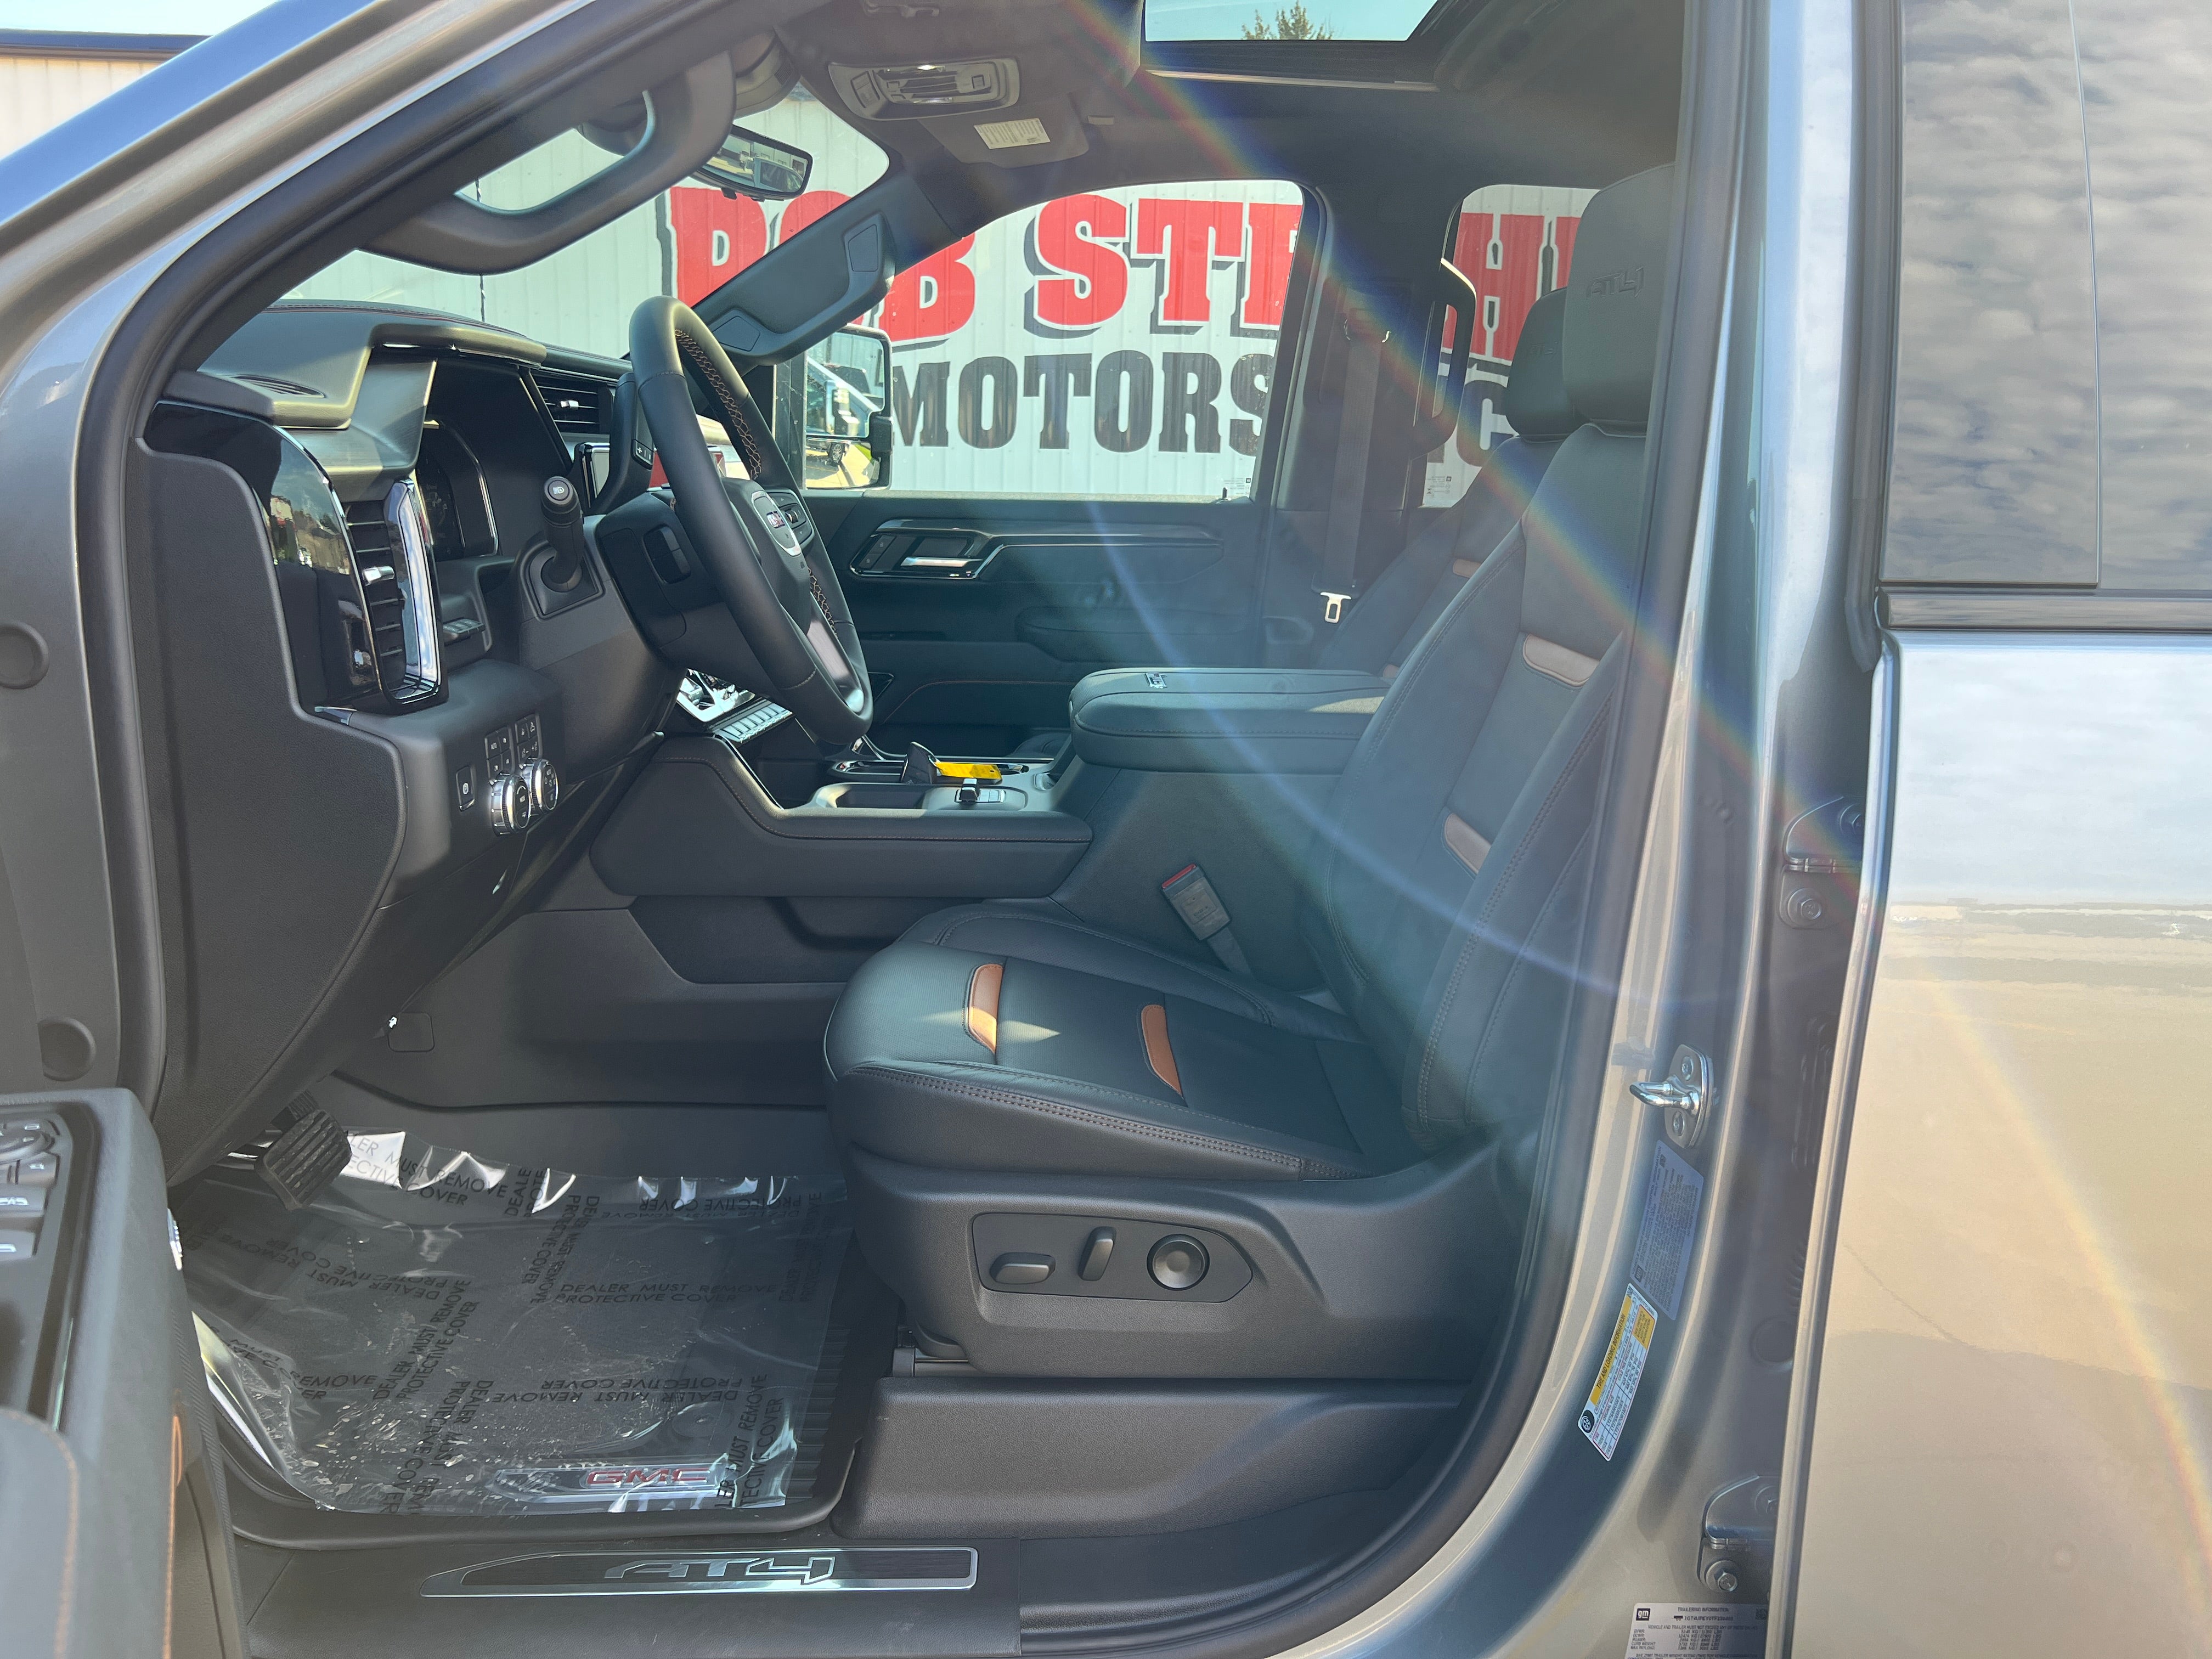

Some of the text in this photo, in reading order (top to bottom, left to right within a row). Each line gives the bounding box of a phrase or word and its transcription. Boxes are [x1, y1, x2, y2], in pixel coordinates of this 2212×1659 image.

[893, 349, 1274, 456] MOTORS
[436, 1169, 509, 1198] REMOVE
[639, 1198, 698, 1212] COVER
[304, 1267, 360, 1288] MUST
[333, 1266, 448, 1289] PROTECTIVE
[521, 1249, 551, 1285] COVER
[368, 1279, 441, 1300] DEALER
[555, 1293, 737, 1305] PROTECTIVE COVER
[560, 1283, 778, 1294] DEALER MUST REMOVE
[373, 1279, 472, 1401] DEALER MUST REMOVE
[395, 1300, 481, 1400] PROTECTIVE COVER
[1605, 1346, 1615, 1367] LOADING
[1612, 1313, 1626, 1344] INFORMATION
[492, 1390, 739, 1403] DEALER MUST REMOVE
[540, 1378, 744, 1391] PROTECTIVE COVER
[453, 1380, 494, 1425] DEALER
[737, 1373, 768, 1431] REMOVE
[757, 1397, 785, 1448] COVER
[379, 1381, 471, 1514] PROTECTIVE COVER
[727, 1435, 750, 1472] MUST
[586, 1466, 711, 1487] GMC
[603, 1555, 836, 1585] AT4
